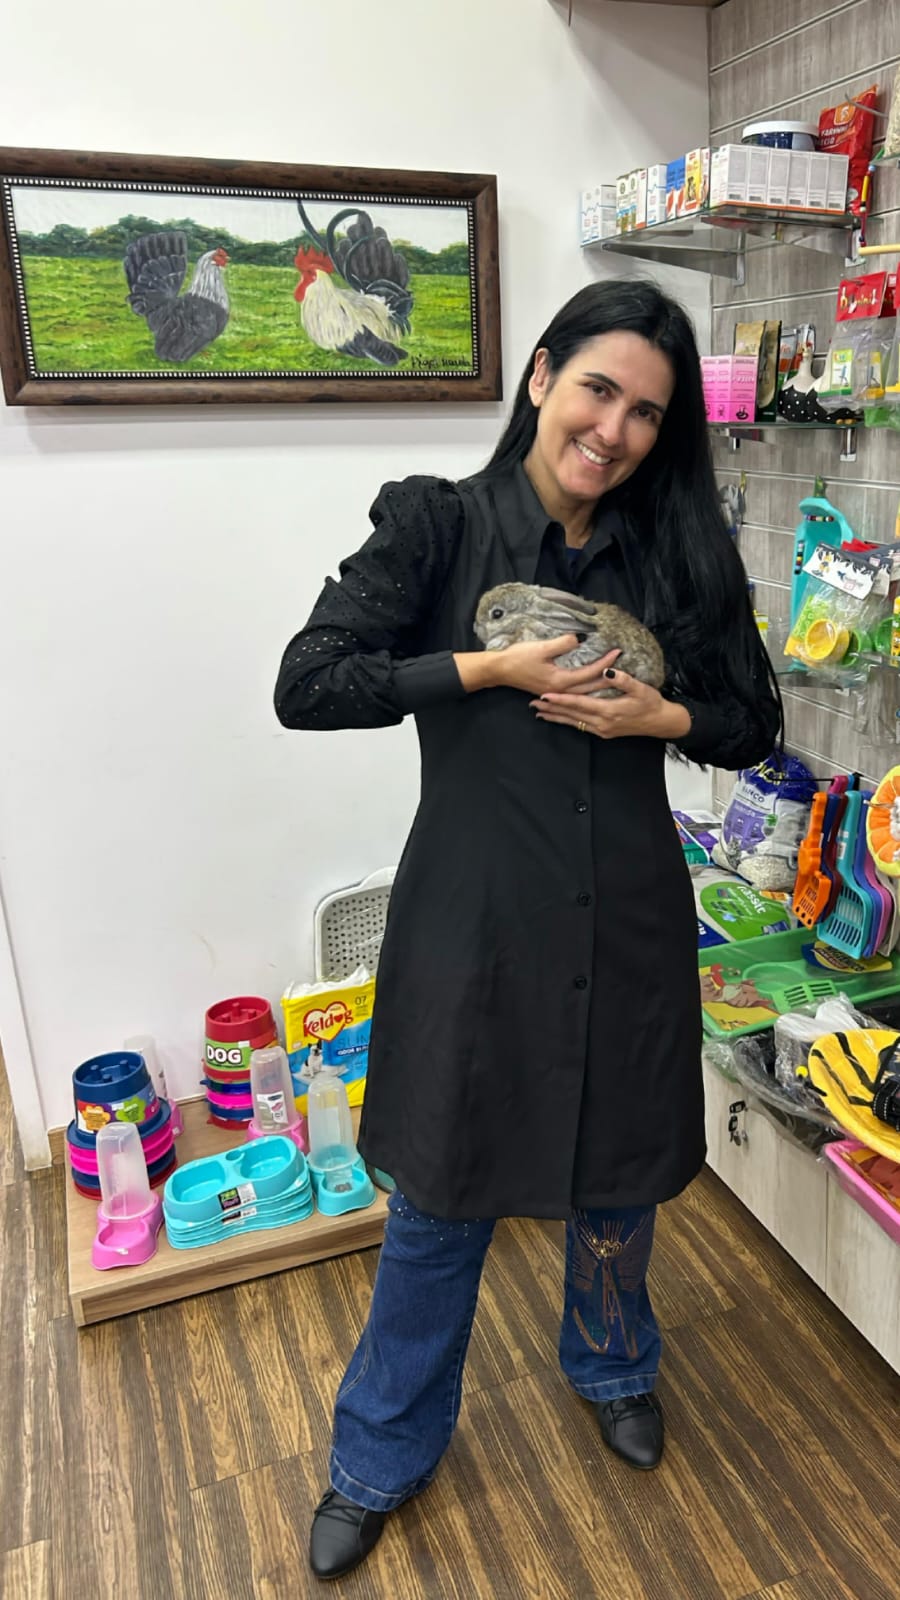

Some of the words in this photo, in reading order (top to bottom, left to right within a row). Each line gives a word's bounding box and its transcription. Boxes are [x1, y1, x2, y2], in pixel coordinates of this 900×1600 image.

[354, 995, 368, 1006] 07
[303, 1009, 354, 1037] Keldog
[206, 1044, 243, 1065] DOG
